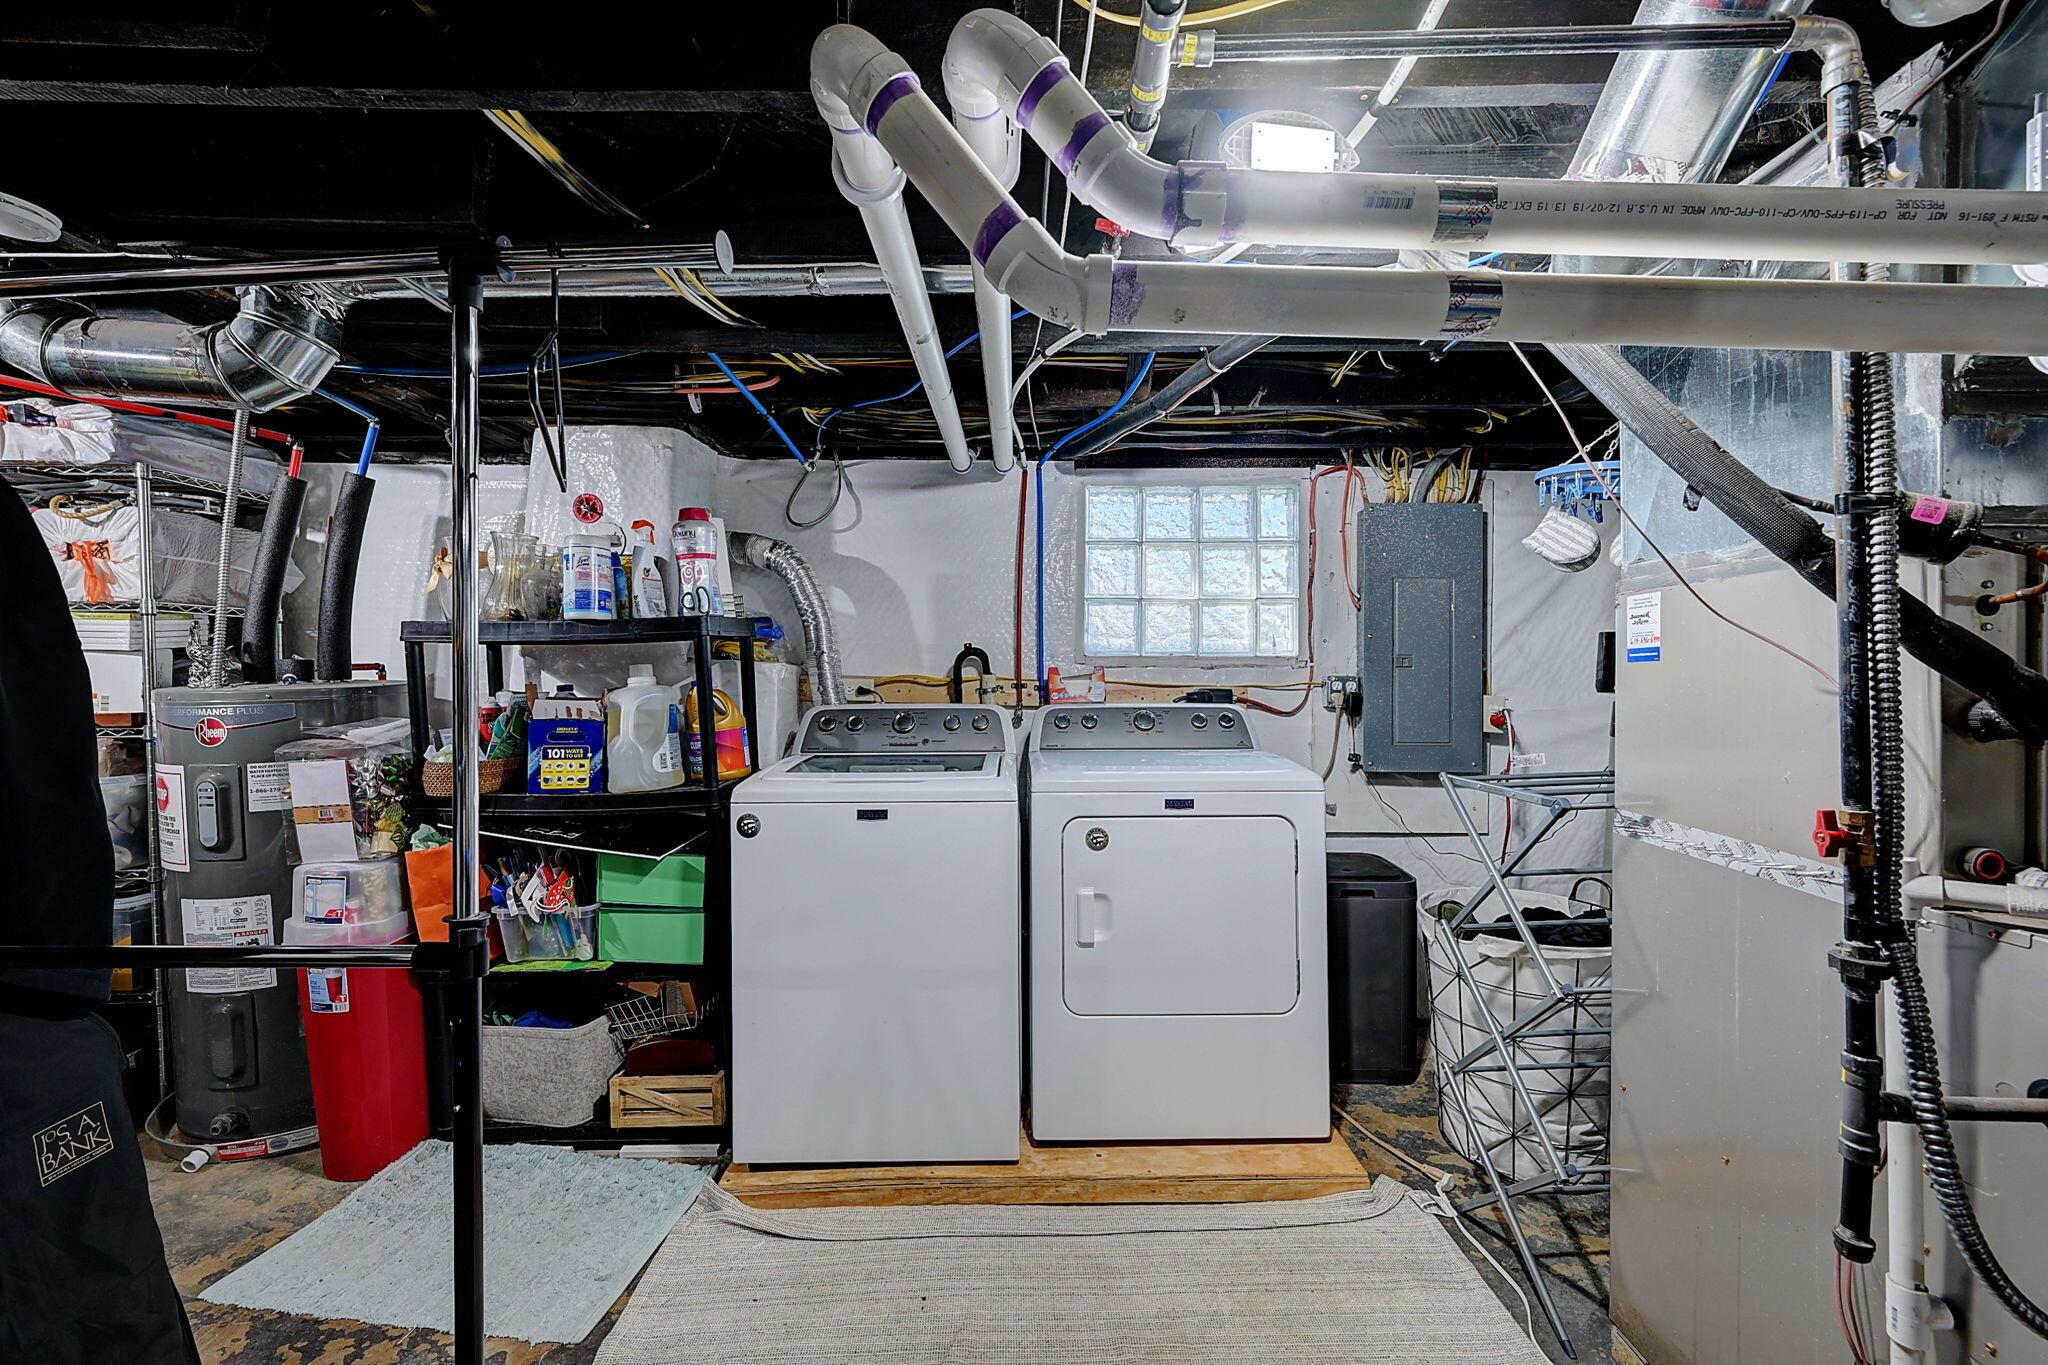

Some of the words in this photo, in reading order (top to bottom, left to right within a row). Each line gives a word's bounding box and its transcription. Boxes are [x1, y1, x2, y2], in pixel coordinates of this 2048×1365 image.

[1572, 202, 1621, 213] 12/07/19
[1662, 203, 1675, 215] IN
[1680, 204, 1706, 216] MADE
[1895, 198, 1946, 211] PRESSURE
[1896, 210, 1918, 222] FOR
[1927, 210, 1949, 222] NOT
[1957, 211, 1997, 223] 891-16
[236, 706, 264, 715] PLUS
[197, 717, 225, 742] Rheem
[547, 748, 565, 759] 101
[249, 786, 281, 794] 1-866-279
[77, 1114, 101, 1136] A.
[41, 1126, 109, 1173] BANK
